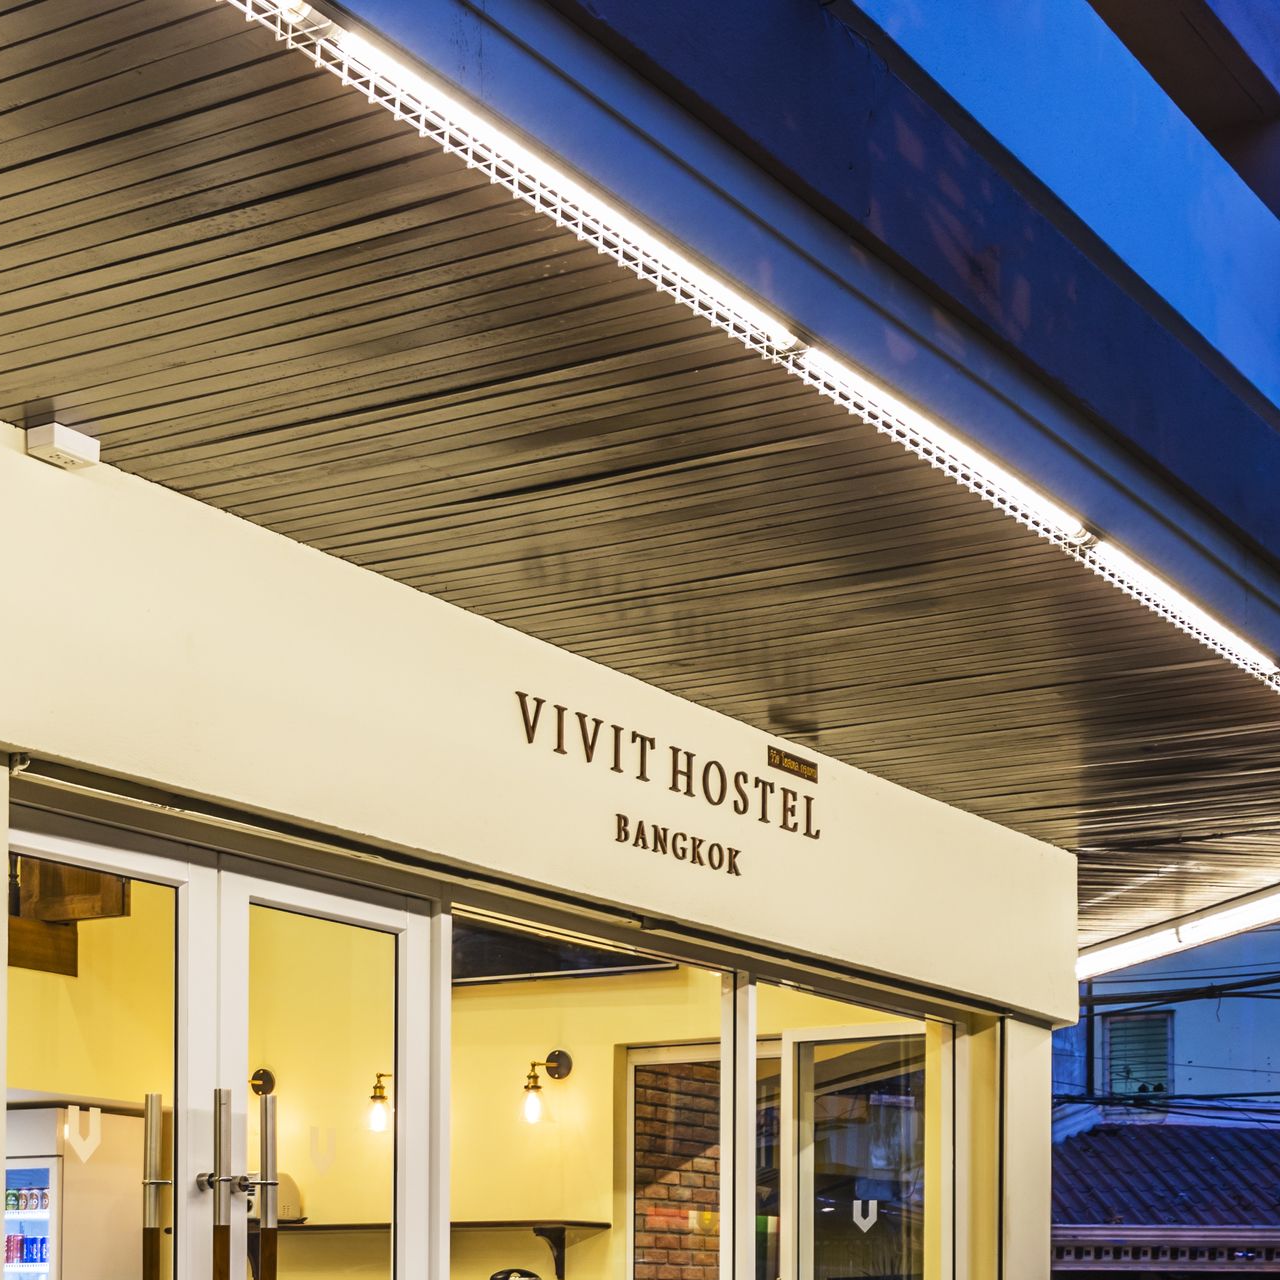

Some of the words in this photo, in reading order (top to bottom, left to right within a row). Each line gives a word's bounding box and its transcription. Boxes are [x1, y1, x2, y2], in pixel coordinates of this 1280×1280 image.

[515, 690, 656, 782] VIVIT
[669, 745, 821, 840] HOSTEL
[615, 813, 742, 877] BANGKOK
